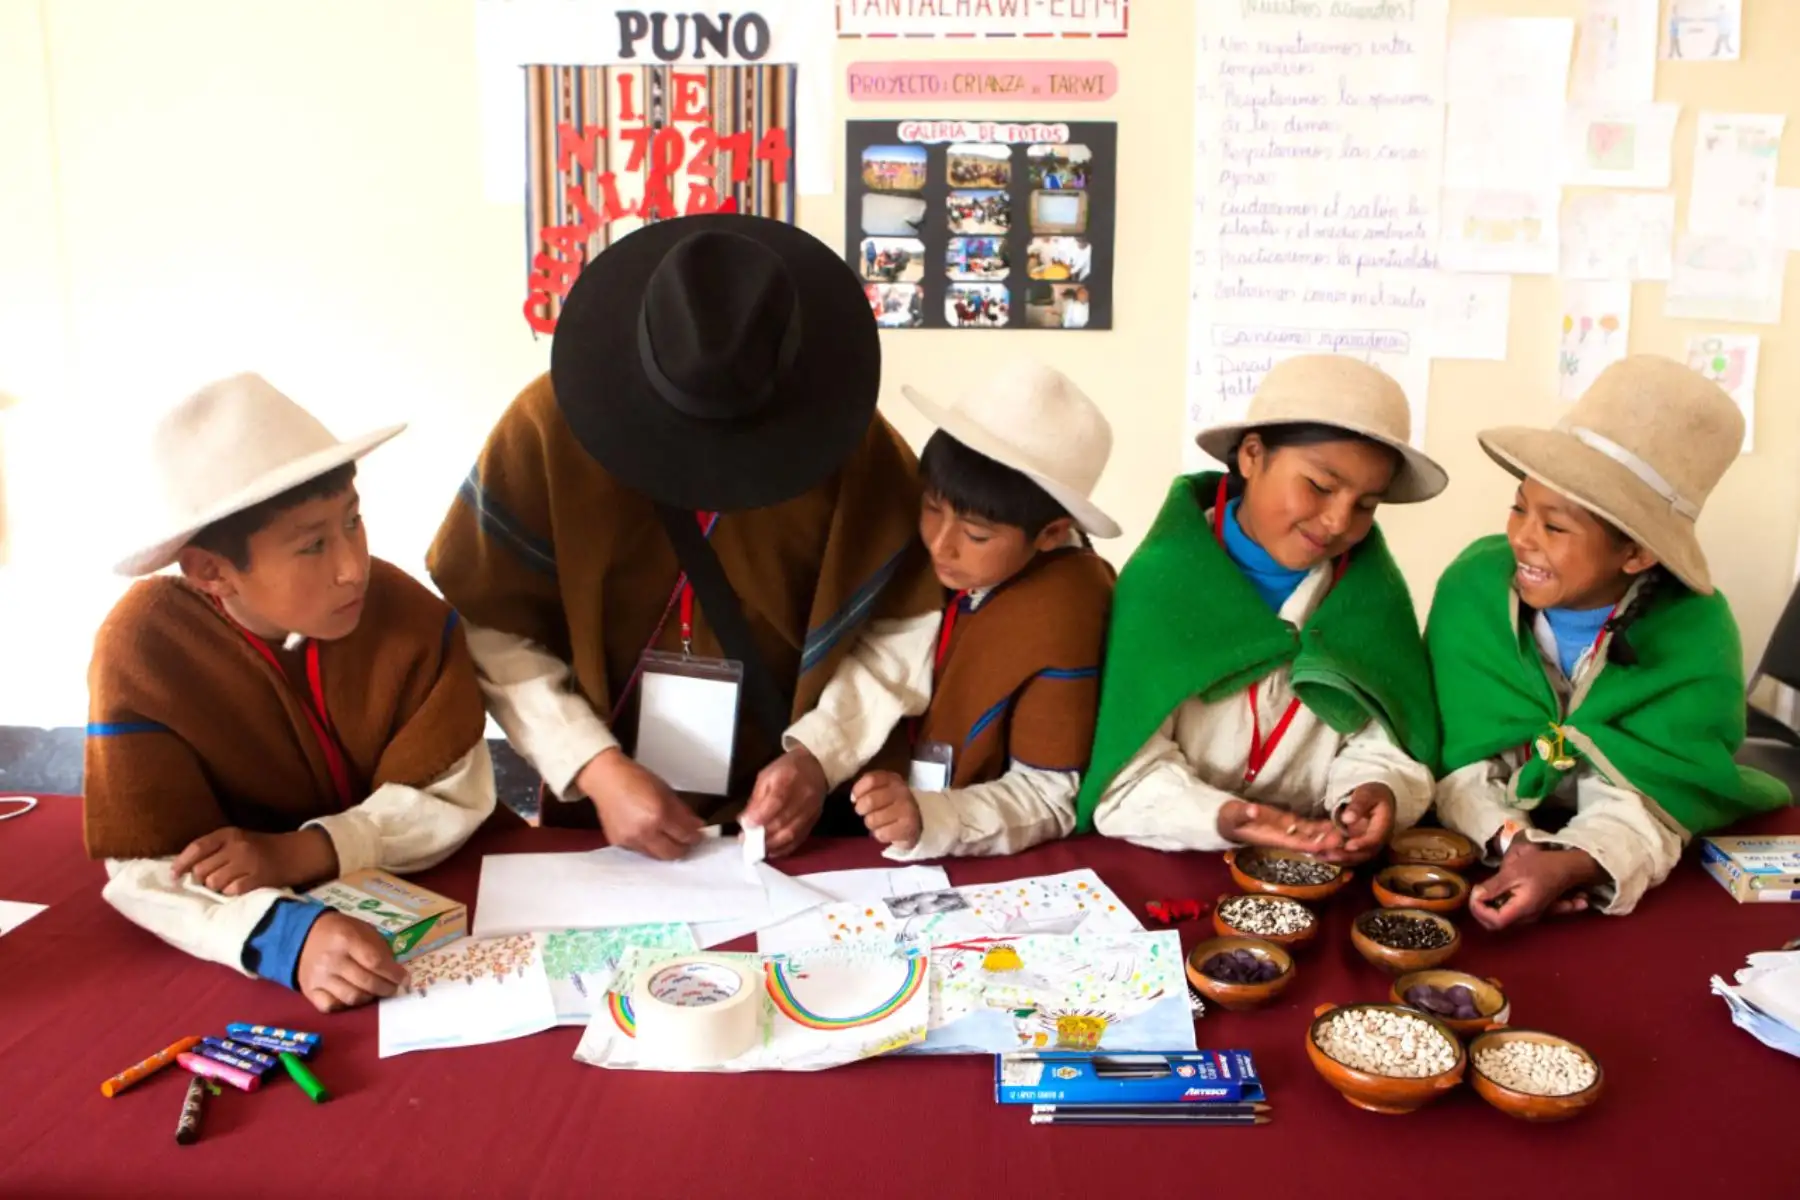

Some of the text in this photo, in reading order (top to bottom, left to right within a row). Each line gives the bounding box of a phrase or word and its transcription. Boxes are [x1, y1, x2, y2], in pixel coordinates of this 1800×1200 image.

[614, 10, 770, 61] PUNO
[953, 73, 1025, 94] CRIANZA
[1048, 73, 1106, 95] TARWI
[978, 124, 997, 142] DE
[1008, 125, 1063, 143] FOTOS
[619, 126, 792, 183] 70214
